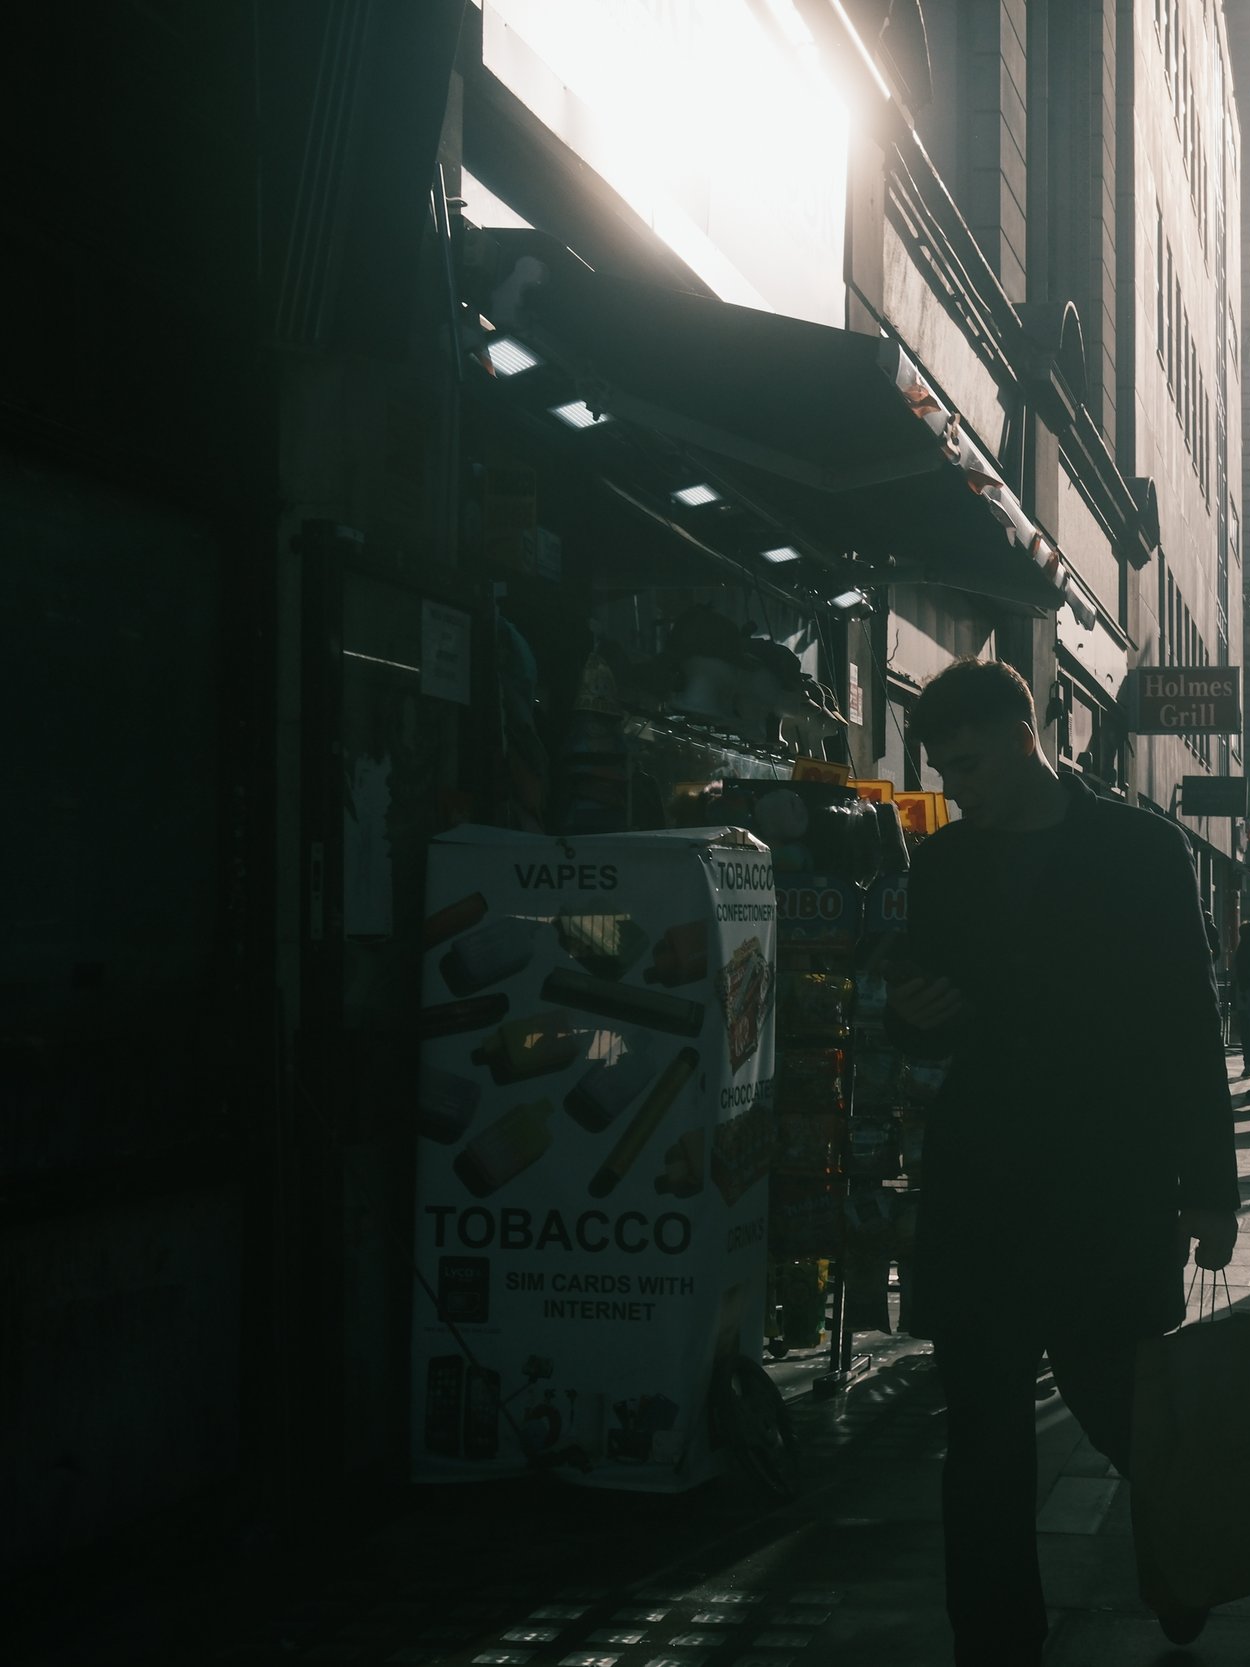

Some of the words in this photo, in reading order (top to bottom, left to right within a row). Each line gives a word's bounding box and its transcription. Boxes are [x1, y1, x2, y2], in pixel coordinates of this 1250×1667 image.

[1143, 674, 1233, 698] Holmes
[1159, 703, 1216, 728] Grill
[514, 863, 618, 890] VAPES
[717, 862, 774, 891] TOBACCO
[716, 903, 775, 922] CONFECTIONERY
[776, 887, 843, 921] RIBO
[424, 1205, 692, 1254] TOBACCO
[727, 1218, 765, 1254] DRINKS
[505, 1272, 545, 1291] SIM
[551, 1273, 632, 1294] CARDS
[639, 1275, 695, 1296] WITH
[543, 1299, 656, 1321] INTERNET
